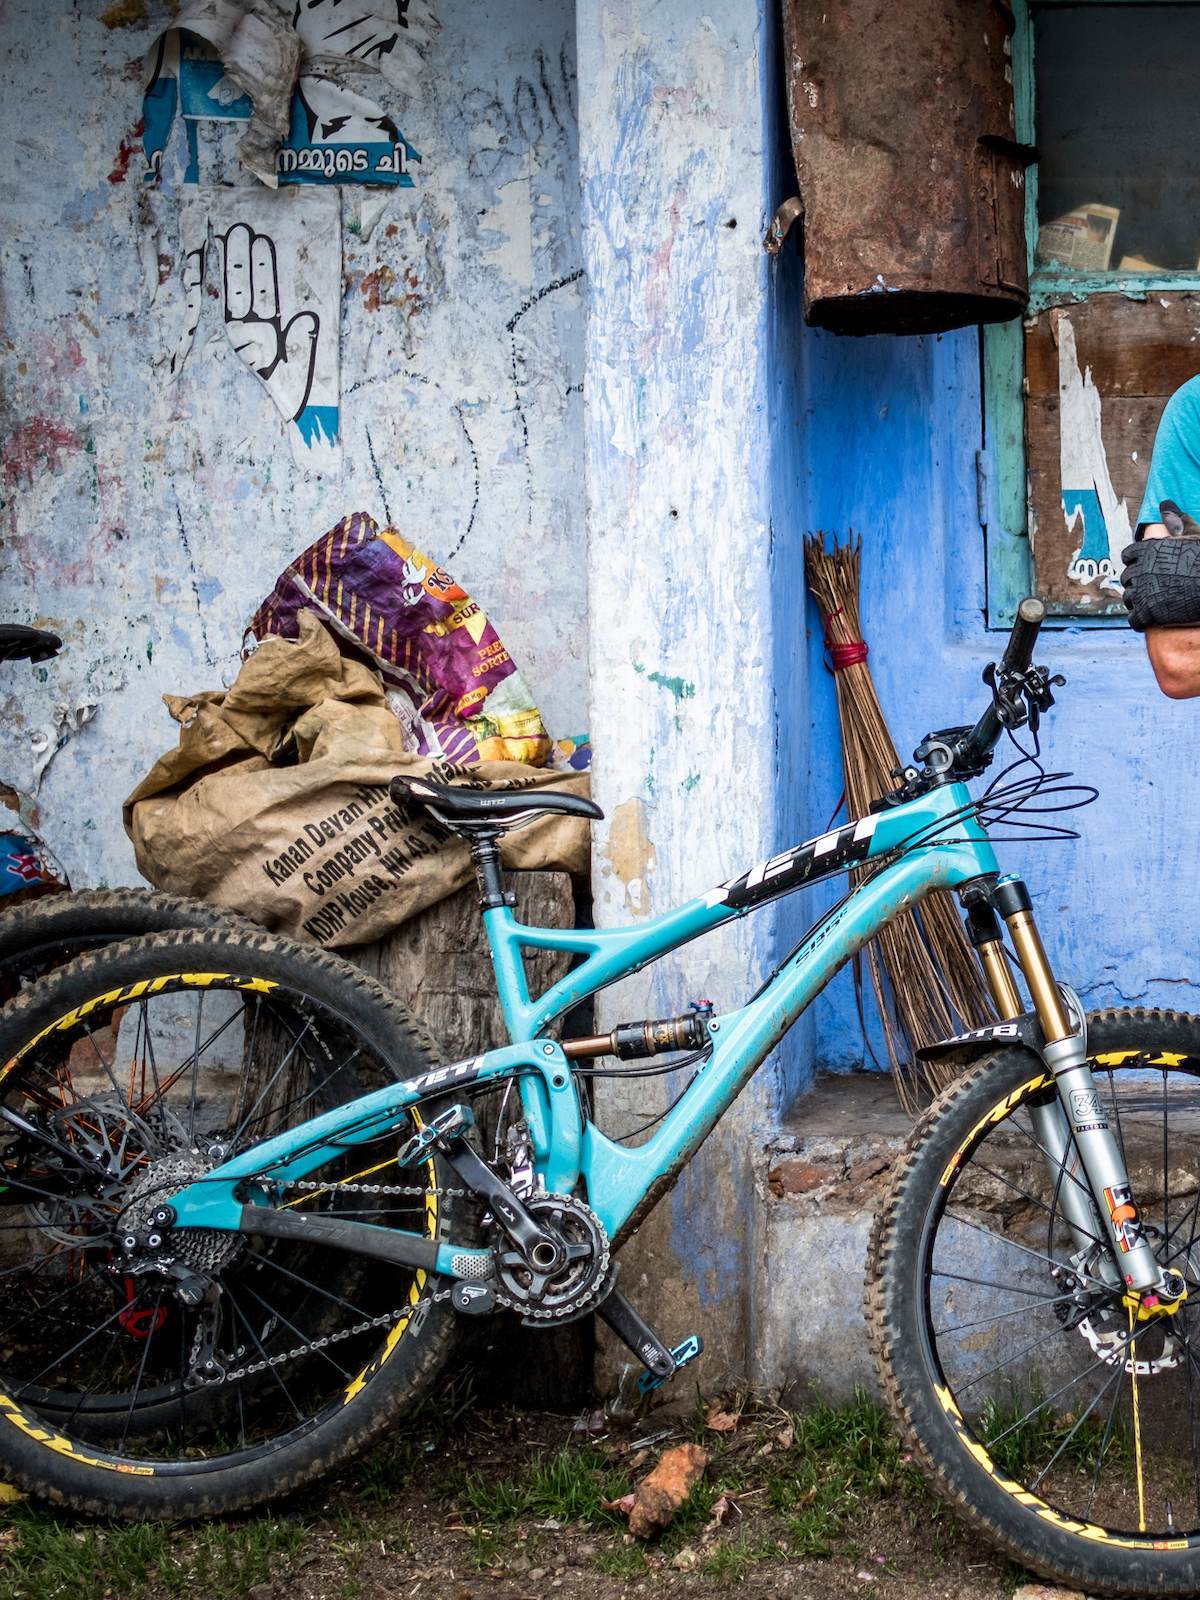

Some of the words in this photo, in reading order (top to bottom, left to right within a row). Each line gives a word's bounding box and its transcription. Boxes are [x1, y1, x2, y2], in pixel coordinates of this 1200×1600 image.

[262, 836, 315, 887] Kanan
[303, 801, 361, 845] Devan
[302, 826, 383, 896] Company
[697, 812, 882, 910] YETI
[302, 901, 350, 945] KDHP
[341, 873, 399, 920] House,
[403, 1055, 486, 1094] YETI
[1074, 1094, 1104, 1117] 34
